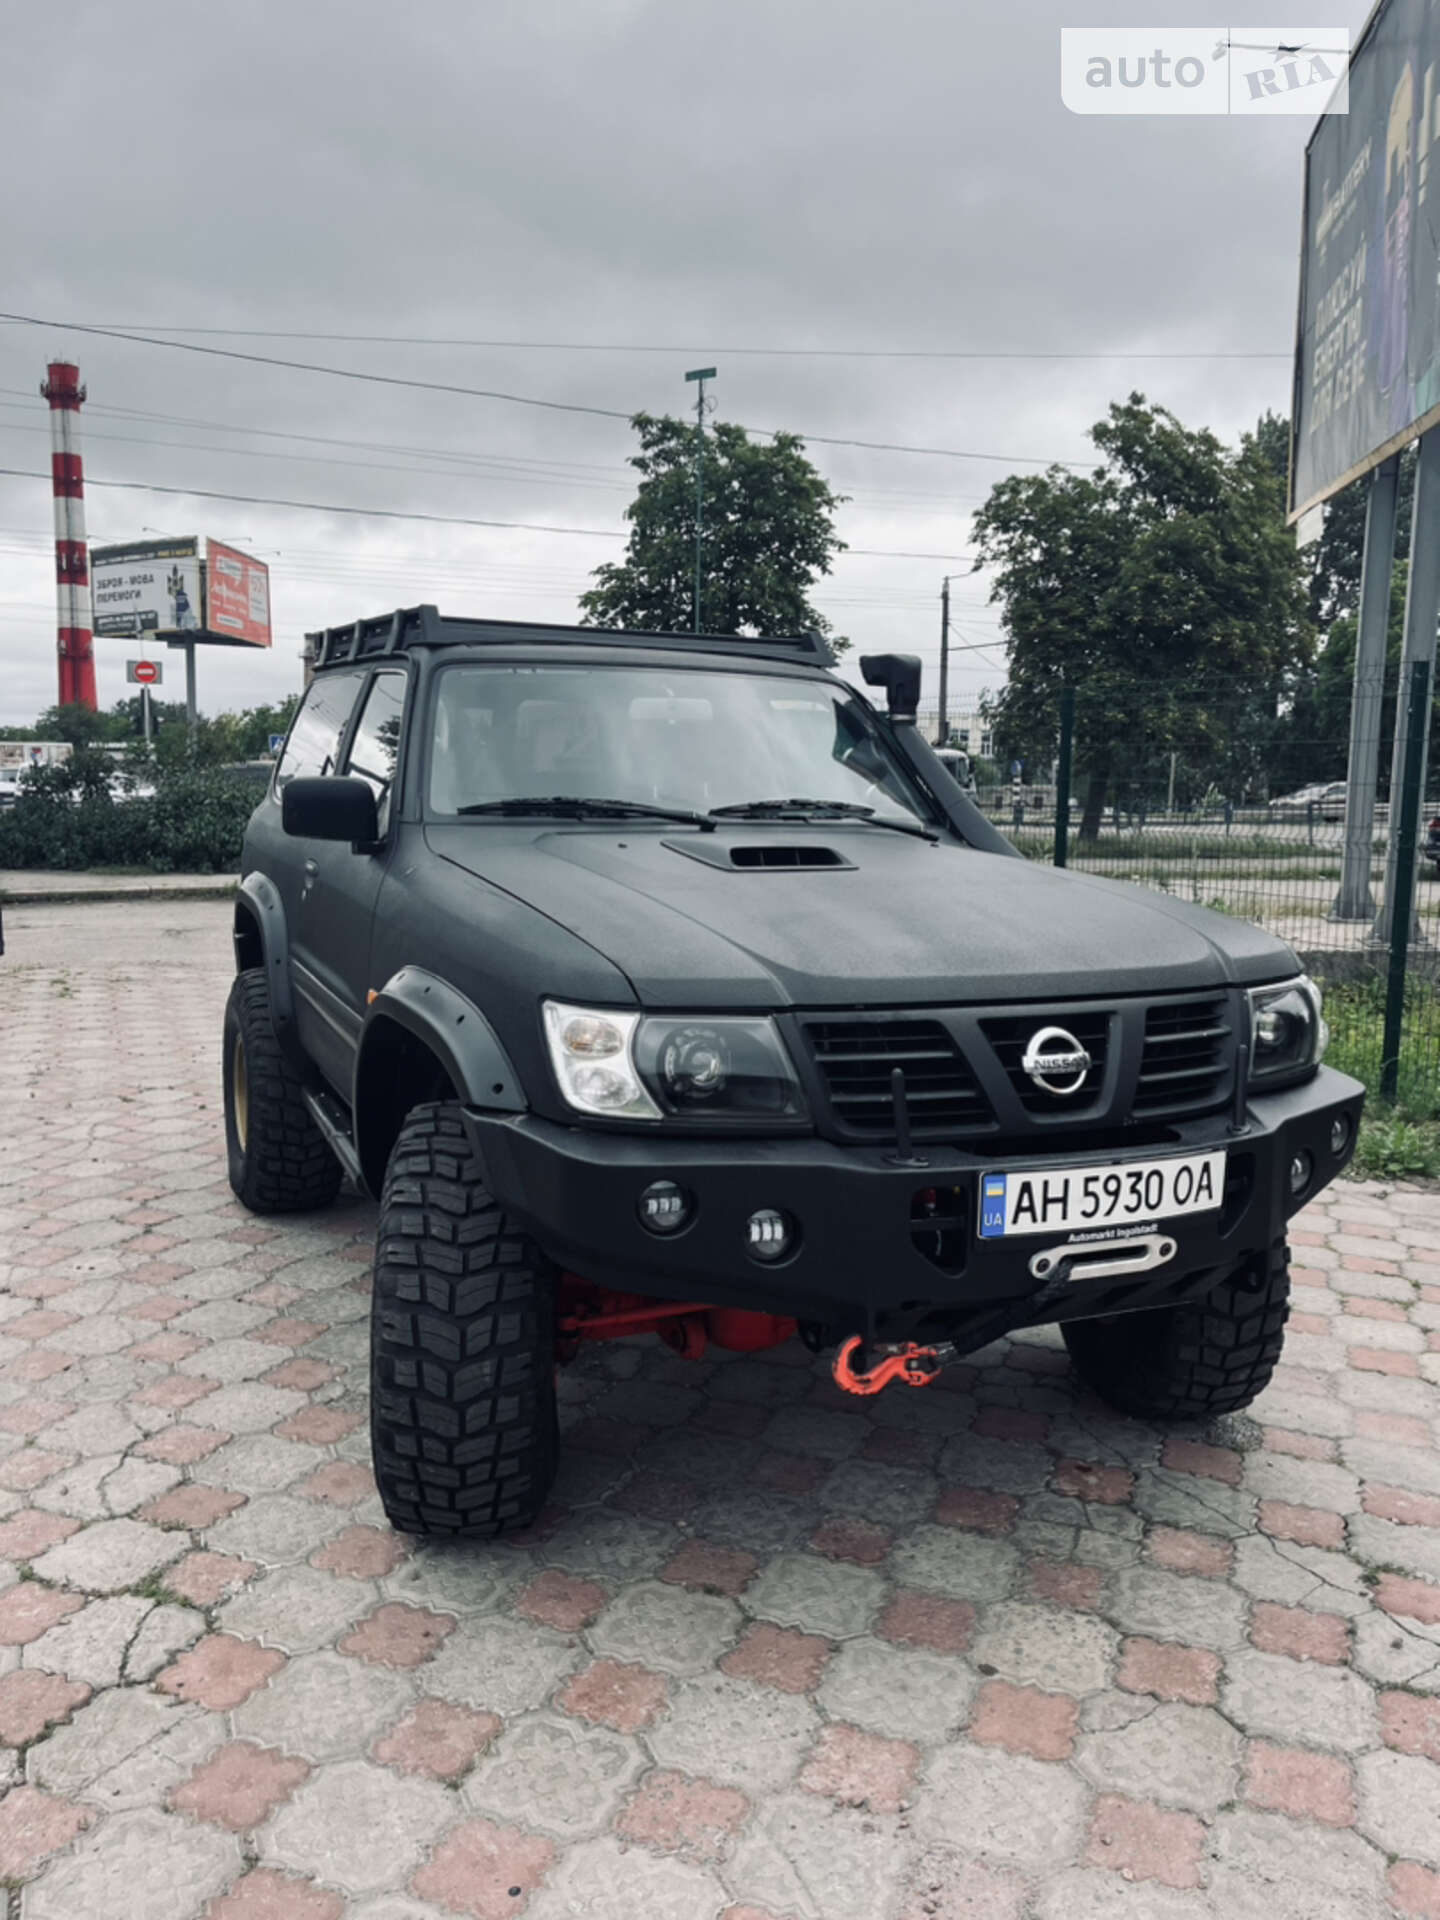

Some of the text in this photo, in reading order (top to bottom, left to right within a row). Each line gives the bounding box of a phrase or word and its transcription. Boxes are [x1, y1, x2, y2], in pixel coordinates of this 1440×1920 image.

[96, 577, 123, 589] ЗБРОЯ
[129, 574, 154, 585] МОВА
[96, 589, 142, 603] ПЕРЕМОГИ
[1012, 1161, 1214, 1225] AH 5930 OA
[984, 1213, 1003, 1227] UA
[1067, 1223, 1159, 1243] Automarkt Ingolstadt
